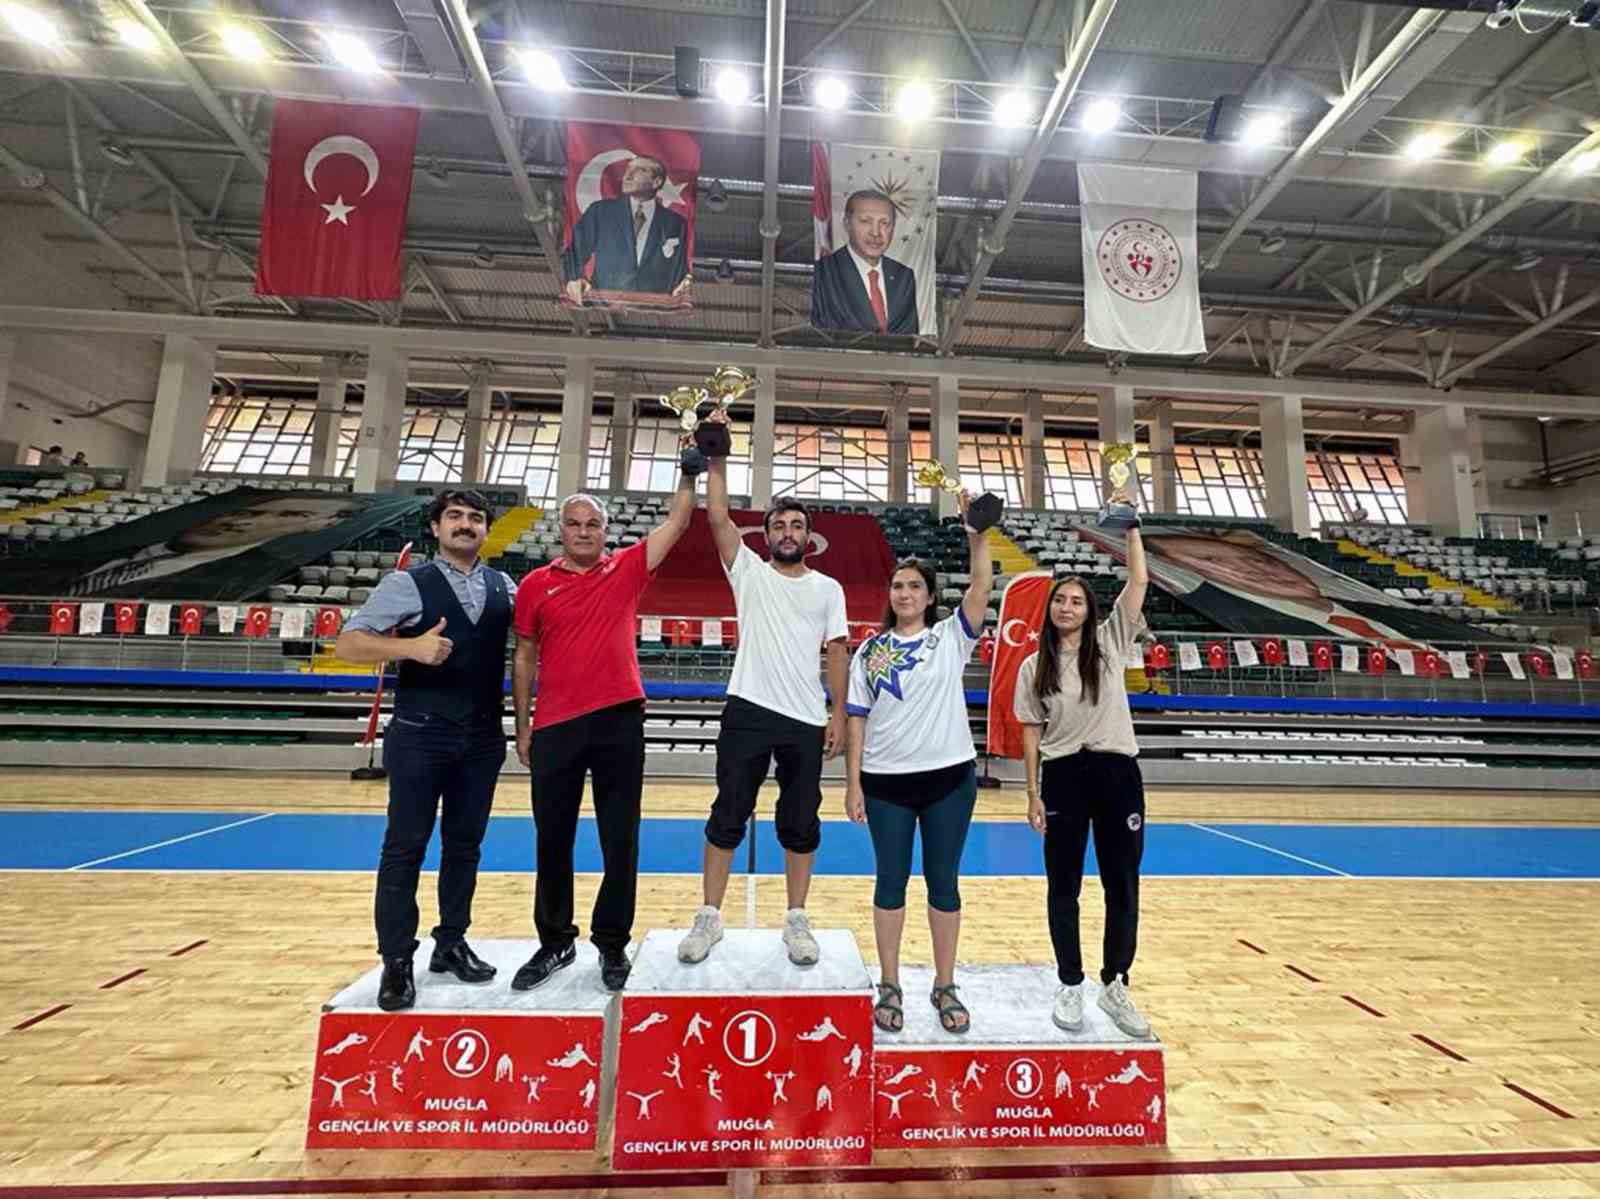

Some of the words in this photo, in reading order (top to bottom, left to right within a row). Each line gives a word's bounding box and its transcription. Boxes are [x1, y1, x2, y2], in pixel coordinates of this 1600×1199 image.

[738, 1017, 757, 1059] 1
[455, 1036, 474, 1071] 2
[1015, 1064, 1033, 1093] 3
[424, 1096, 488, 1111] MUĞLA
[995, 1105, 1053, 1119] MUĞLA
[318, 1119, 387, 1135] GENÇLİK
[392, 1121, 413, 1133] VE
[416, 1120, 460, 1133] SPOR
[463, 1119, 479, 1133] İL
[481, 1119, 589, 1134] MÜDÜRLÜĞÜ
[717, 1117, 775, 1132] MUĞLA
[901, 1125, 967, 1141] GENÇLİK
[970, 1126, 988, 1139] VE
[991, 1126, 1030, 1138] SPOR
[1033, 1124, 1046, 1138] İL
[1049, 1123, 1145, 1138] MÜDÜRLÜĞÜ
[623, 1138, 687, 1156] GENÇLİK
[690, 1139, 708, 1152] VE
[712, 1139, 751, 1152] SPOR
[754, 1138, 767, 1151] İL
[770, 1136, 865, 1151] MÜDÜRLÜĞÜ
